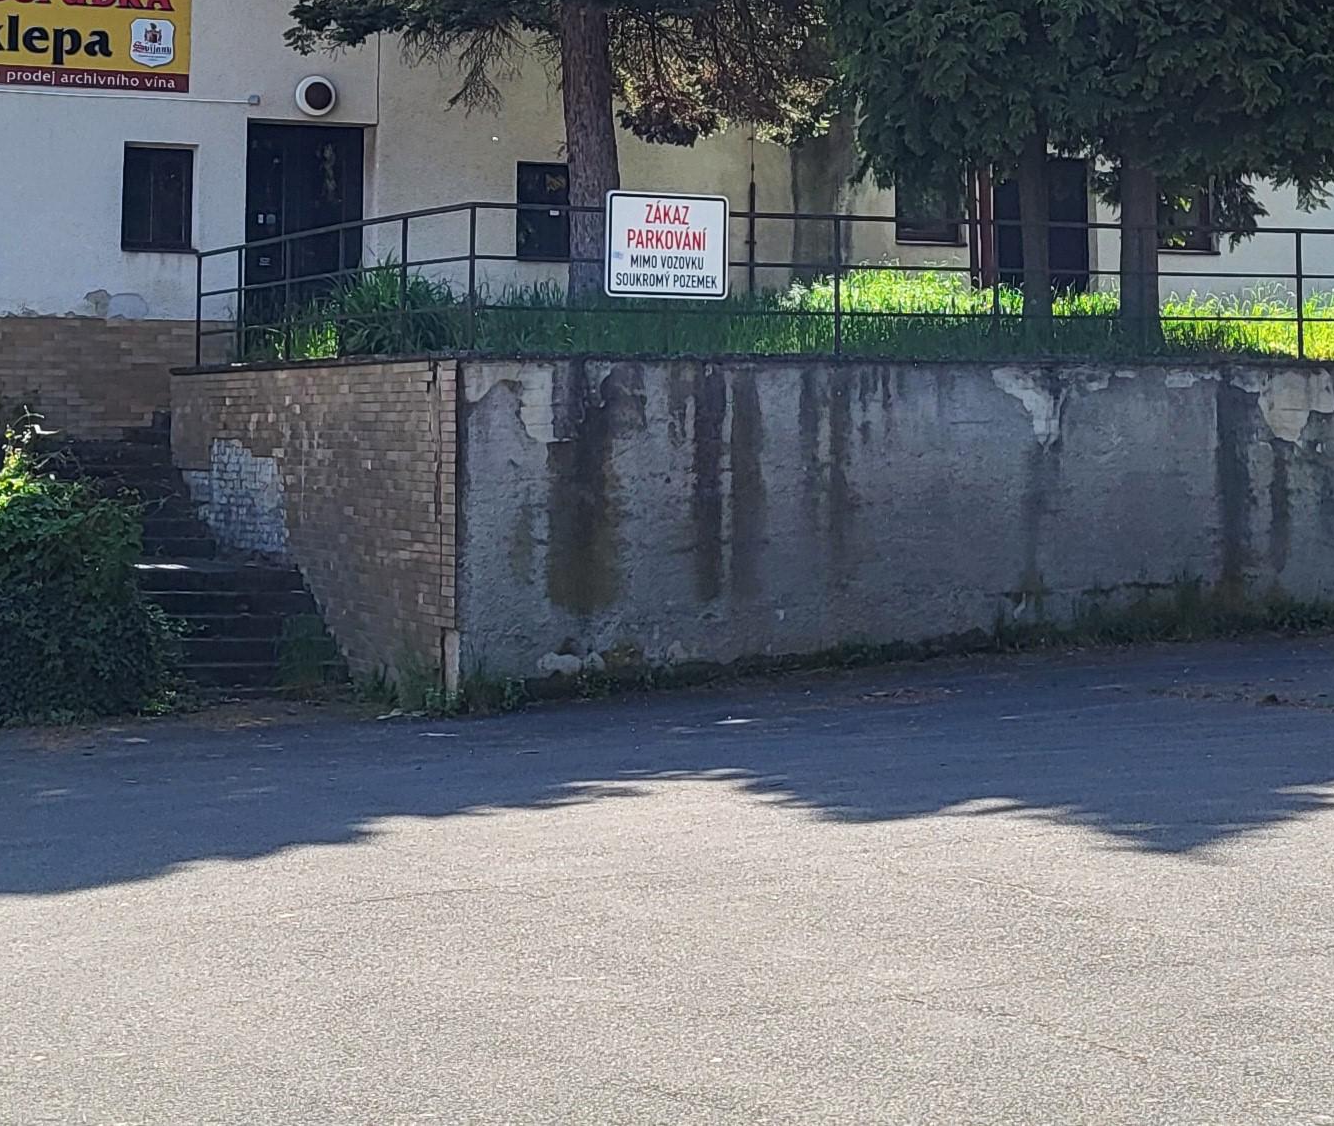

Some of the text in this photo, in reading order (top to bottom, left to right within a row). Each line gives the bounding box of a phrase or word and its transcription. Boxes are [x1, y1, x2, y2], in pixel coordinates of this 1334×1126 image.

[6, 68, 55, 86] prodej
[60, 72, 140, 88] archivního
[144, 76, 176, 89] vína
[645, 200, 690, 225] ZÁKAZ
[627, 227, 707, 251] PARKOVÁNÍ
[630, 254, 704, 270] MIMO VOZOVKU
[616, 271, 717, 289] SOUKROMÝ POZEMEK
